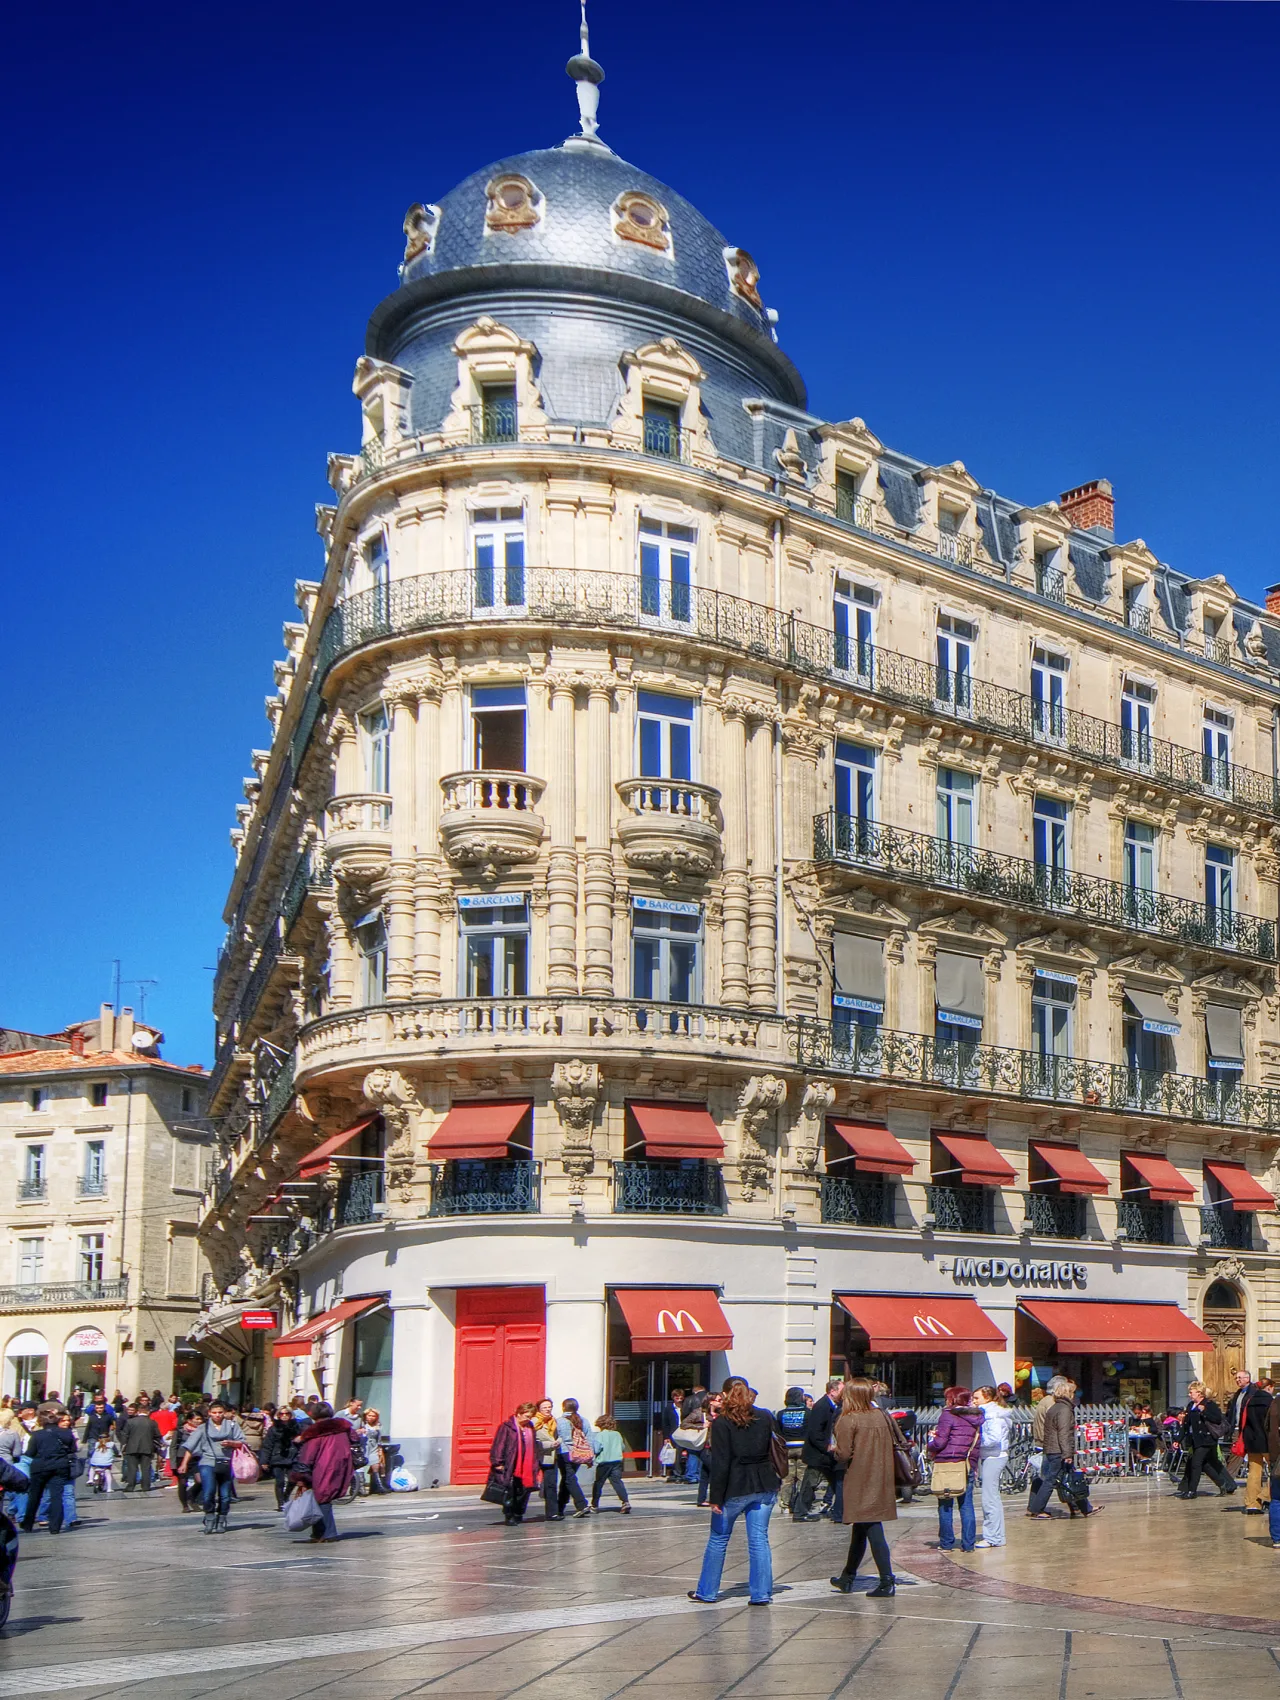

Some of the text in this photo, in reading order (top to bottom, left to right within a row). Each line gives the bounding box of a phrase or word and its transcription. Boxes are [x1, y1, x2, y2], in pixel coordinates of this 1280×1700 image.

[472, 895, 522, 906] BARCLAYS
[650, 899, 698, 913] BARCLAYS
[1045, 971, 1077, 983] BARCLAYS
[845, 996, 882, 1010] BARCLAYS
[948, 1013, 981, 1026] BARCLAYS
[1151, 1023, 1180, 1034] BARCLAYS
[954, 1257, 1088, 1282] McDonald's
